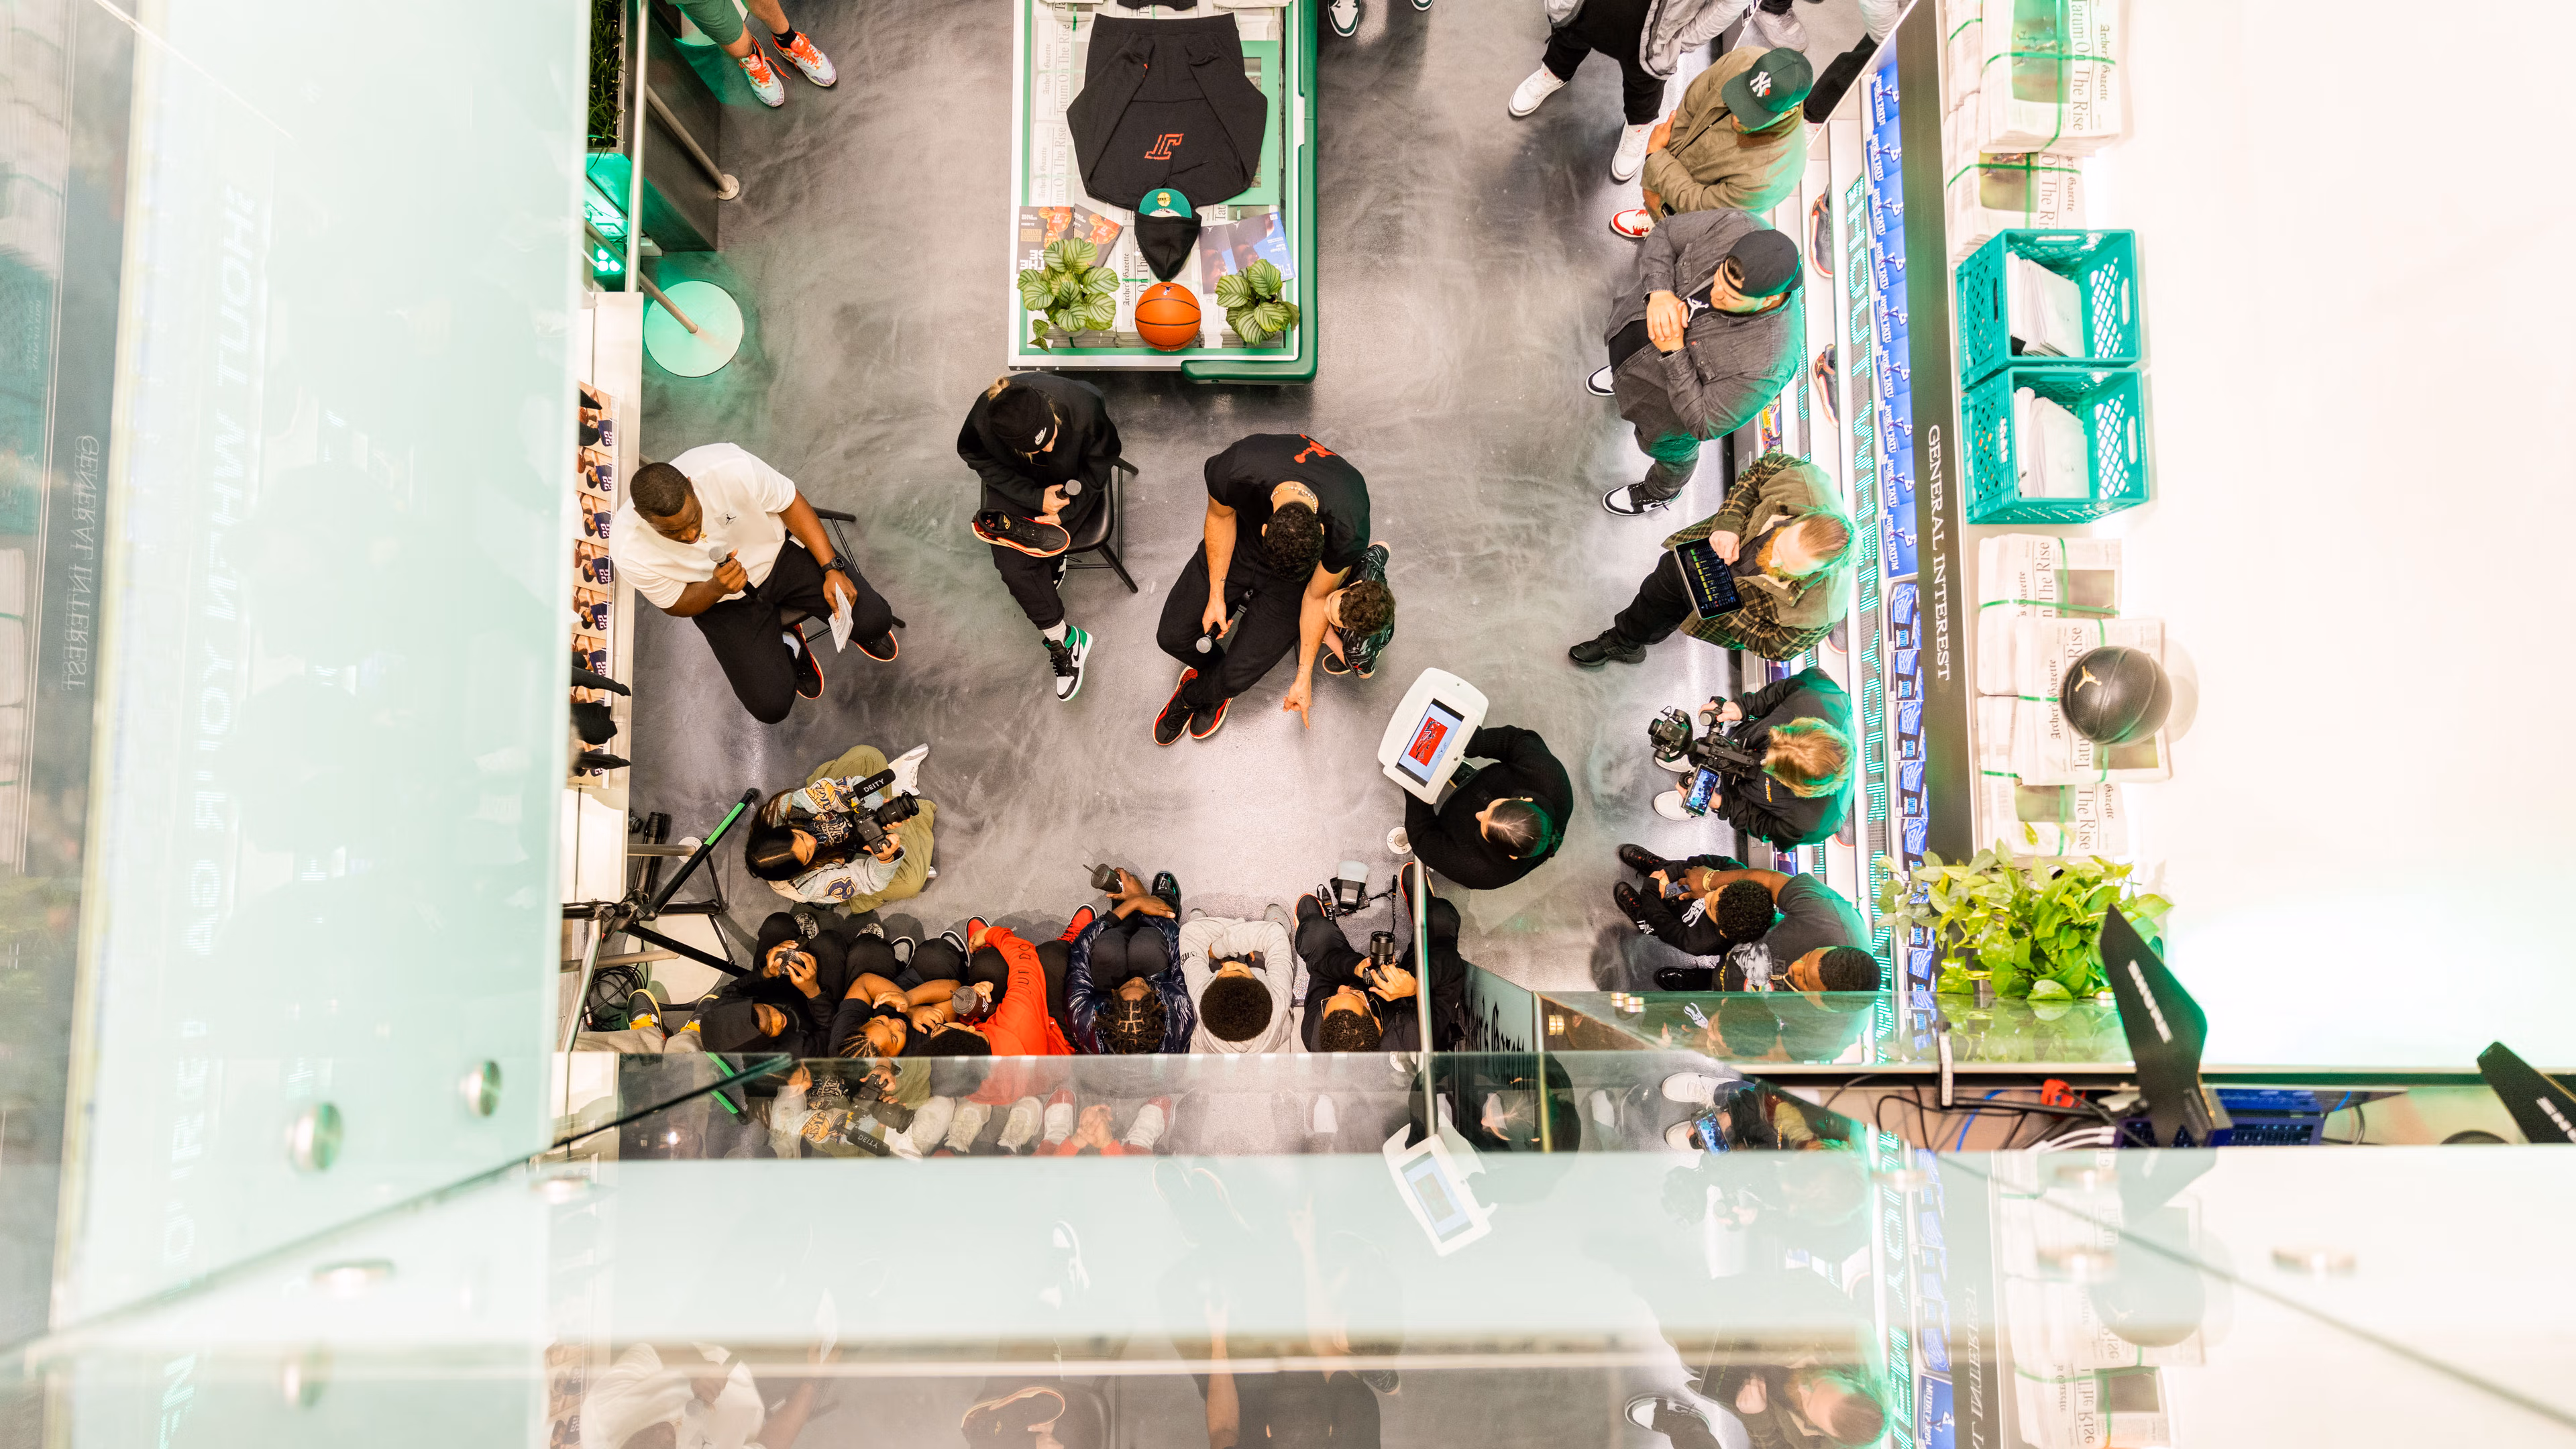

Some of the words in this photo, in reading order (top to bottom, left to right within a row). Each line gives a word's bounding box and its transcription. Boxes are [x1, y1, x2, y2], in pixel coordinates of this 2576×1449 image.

[1059, 24, 1070, 42] Rise
[2100, 25, 2110, 62] Archer's
[1058, 46, 1069, 65] The
[2074, 42, 2091, 61] On
[2073, 68, 2090, 95] The
[2100, 65, 2110, 101] Gazette
[1056, 85, 1069, 113] Tatum
[1877, 103, 1886, 125] TATU
[2072, 101, 2089, 131] Rise
[1055, 127, 1067, 148] Rise
[1054, 150, 1065, 168] The
[1874, 159, 1884, 181] TATU
[2041, 179, 2057, 205] The
[2066, 177, 2076, 212] Gazette
[1876, 213, 1885, 236] TATU
[2039, 211, 2055, 229] Ris
[1020, 259, 1045, 270] THE
[1136, 258, 1148, 275] The
[1880, 266, 1888, 289] TATU
[1882, 320, 1892, 343] TATU
[1884, 374, 1894, 398] TATU
[603, 431, 612, 445] 22
[1887, 429, 1896, 453] TATU
[602, 476, 612, 490] 22
[1927, 424, 1945, 550] GENERAL
[1853, 400, 1879, 612] WHEN
[1888, 484, 1897, 508] TATU
[600, 523, 610, 537] 22
[1889, 540, 1898, 570] TATUM
[2035, 542, 2051, 572] Rise
[599, 569, 610, 582] 22
[2038, 577, 2053, 602] The
[598, 614, 607, 629] 22
[1933, 553, 1949, 681] INTEREST
[2064, 628, 2086, 659] Rise
[1860, 629, 1887, 826] YOUR
[2076, 738, 2091, 771] Tatu
[863, 778, 885, 793] DEITY
[2077, 786, 2094, 815] The
[2104, 784, 2115, 819] Gazette
[2078, 820, 2096, 850] Rise
[1018, 944, 1030, 959] DO
[1775, 961, 1784, 991] KIH
[2127, 959, 2174, 1044] SHURE
